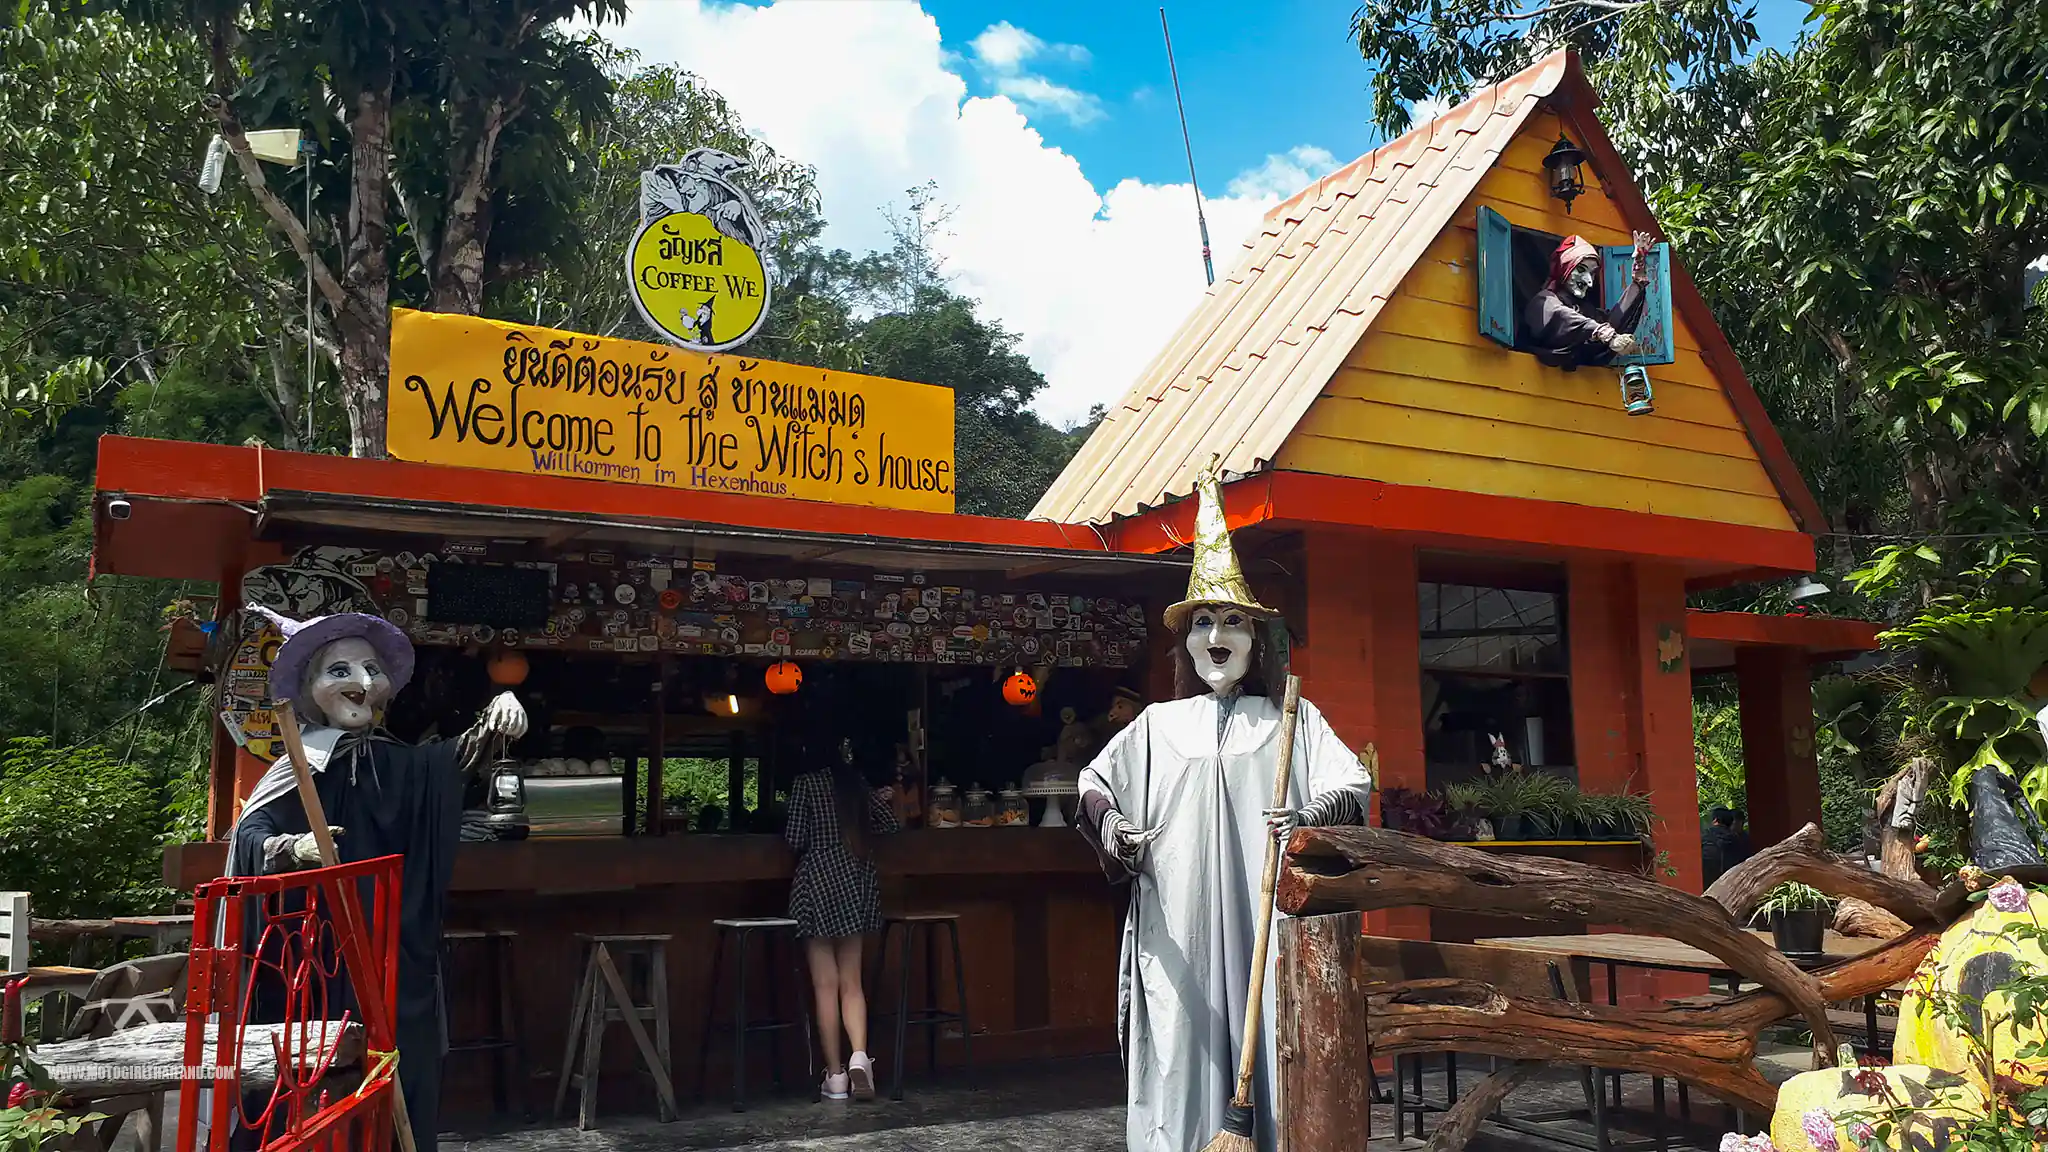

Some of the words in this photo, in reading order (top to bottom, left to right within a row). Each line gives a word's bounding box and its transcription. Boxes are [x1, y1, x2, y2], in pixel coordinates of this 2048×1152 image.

[405, 374, 615, 457] Welcome
[628, 402, 661, 463] to
[502, 330, 686, 405] ยินดีต้อนรับ
[697, 356, 720, 420] สู่
[731, 359, 865, 429] บ้านแม่มด
[531, 449, 640, 482] Willkommen
[654, 462, 676, 484] im
